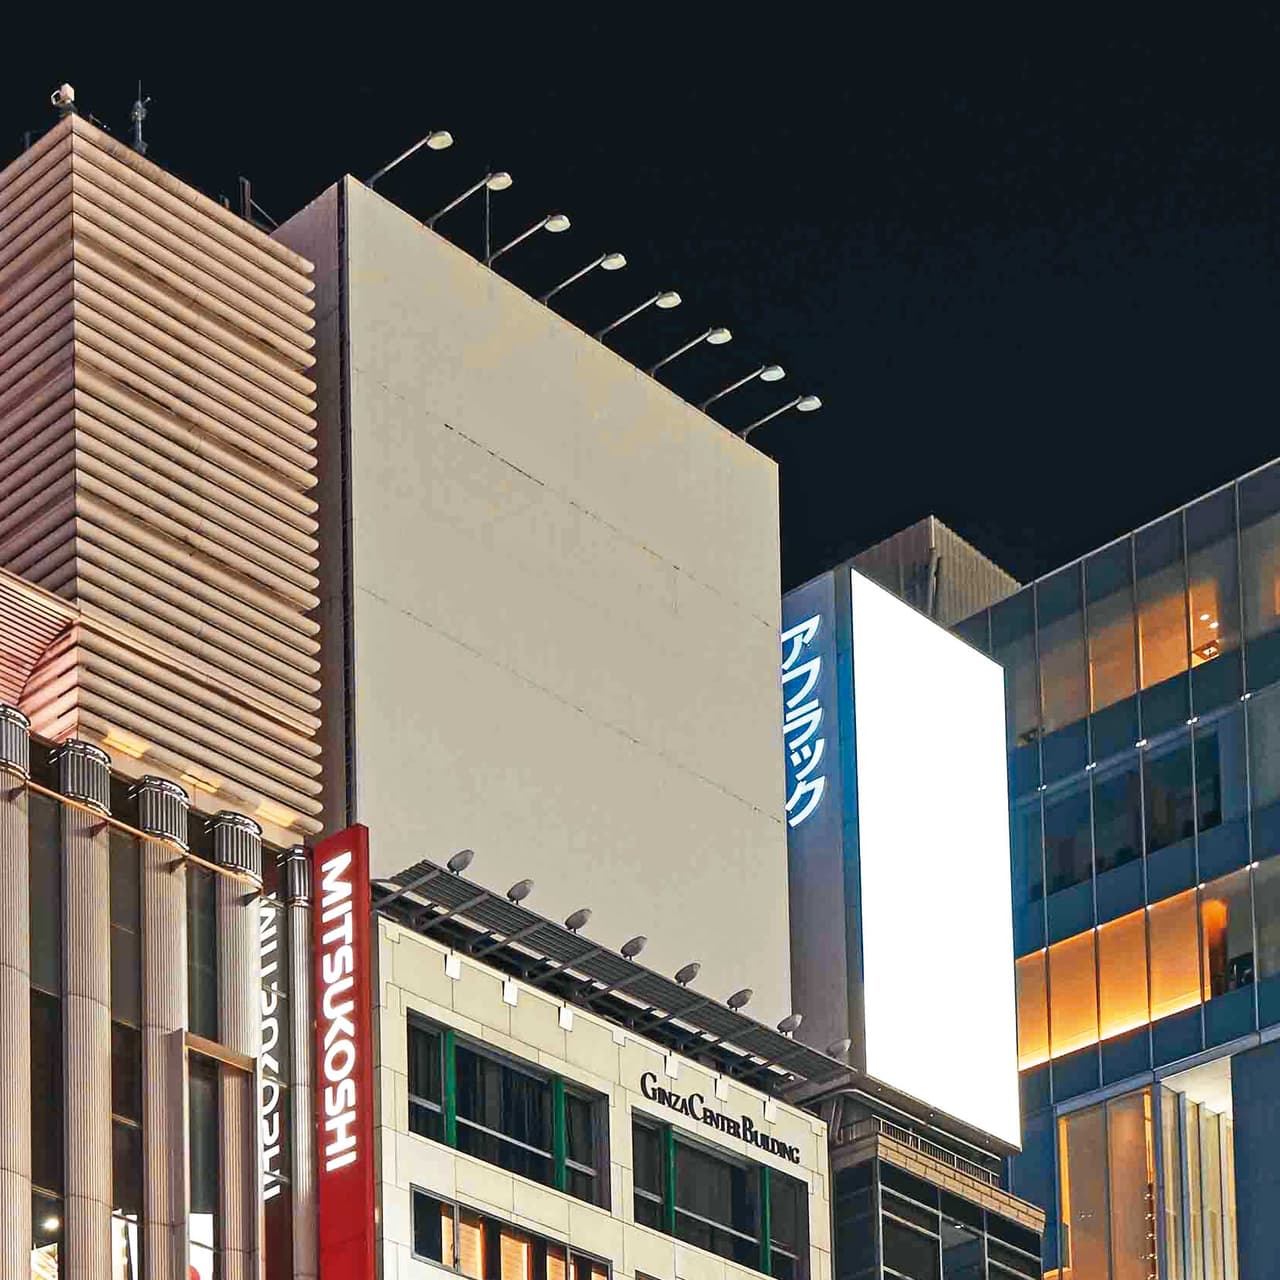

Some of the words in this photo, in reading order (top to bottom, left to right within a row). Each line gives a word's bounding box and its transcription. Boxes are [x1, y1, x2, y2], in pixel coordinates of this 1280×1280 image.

[780, 614, 826, 828] アフラック
[321, 851, 357, 1173] MITSUKOSHI
